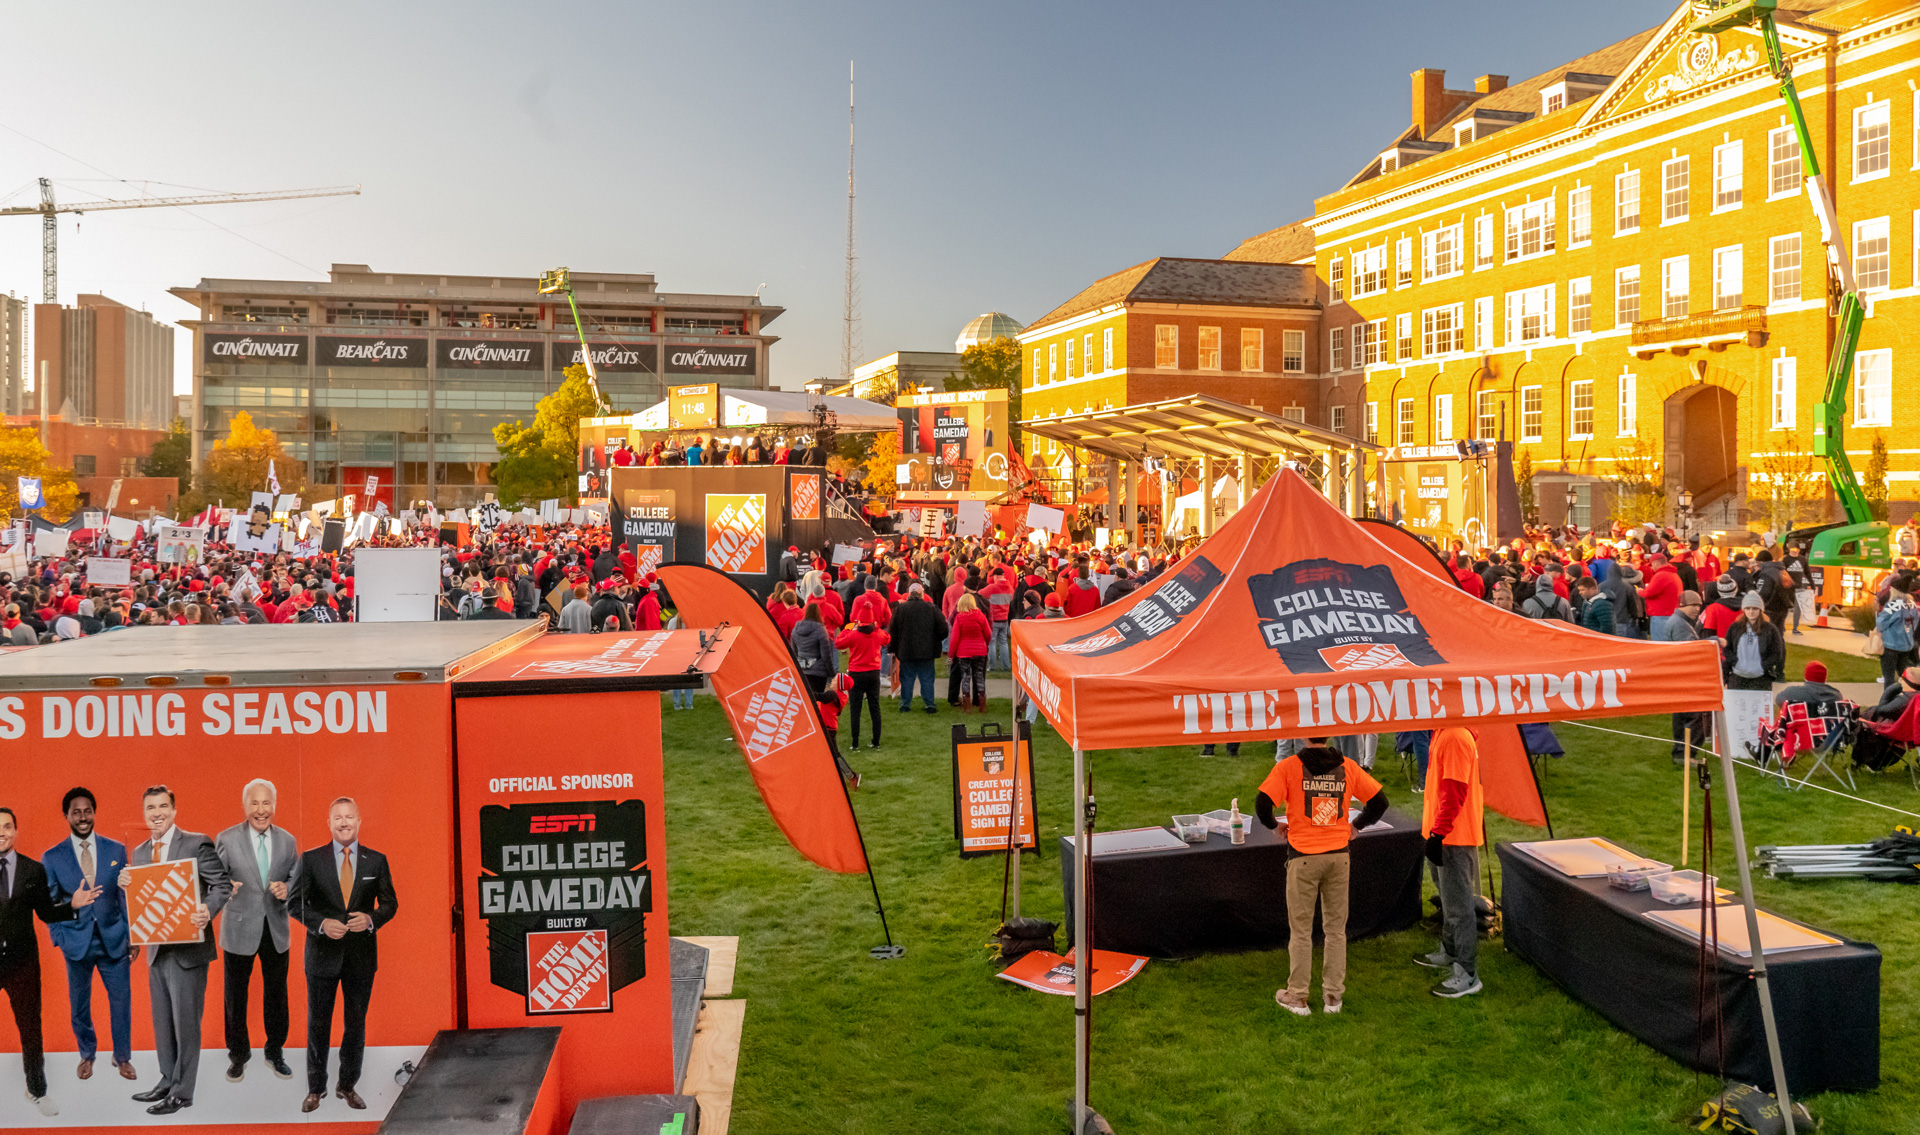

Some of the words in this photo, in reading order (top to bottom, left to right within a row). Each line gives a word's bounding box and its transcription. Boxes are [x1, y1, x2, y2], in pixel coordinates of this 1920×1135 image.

[212, 339, 299, 357] CINCINNATI
[336, 341, 408, 359] BEARCATS
[450, 344, 530, 362] CINCINNATI
[571, 348, 639, 365] BARCATS
[671, 349, 748, 367] CINCINNATI
[958, 391, 987, 402] DEPOT
[682, 402, 705, 415] 11:48
[938, 417, 964, 426] COLLEGE
[933, 427, 969, 438] GAMEDAY
[1430, 446, 1460, 457] GAMEDA
[794, 480, 805, 496] THE
[1421, 477, 1444, 485] COLLEGE
[639, 495, 660, 503] ESPN
[792, 475, 819, 518] HOME
[1418, 488, 1448, 498] GAMEDAY
[630, 507, 669, 519] COLLEGE
[802, 493, 819, 519] DEPOT
[712, 503, 736, 534] THE
[624, 521, 675, 537] GAMEDAY
[707, 494, 765, 570] HOME
[728, 524, 764, 572] DEPOT
[1294, 567, 1351, 586] ESPN
[1273, 587, 1390, 616] COLLEGE
[1263, 610, 1418, 646] GAMEDAY
[1334, 636, 1359, 644] BUILT
[1336, 649, 1364, 664] THE
[743, 692, 765, 724] THE
[1173, 690, 1282, 734] THE
[1297, 678, 1447, 728] HOME
[1458, 668, 1626, 718] DEPOT
[42, 693, 186, 738] DOING
[202, 691, 387, 736] SEASON
[749, 672, 793, 755] HOME
[773, 693, 804, 747] DEPOT
[489, 776, 557, 793] OFFICIAL
[561, 773, 634, 790] SPONSOR
[968, 780, 998, 789] CREATE
[1000, 779, 1021, 787] YOU
[1303, 781, 1345, 792] GAMEDAY
[1312, 798, 1338, 825] HOME
[1316, 801, 1326, 812] THE
[529, 813, 596, 834] ESPN
[971, 818, 995, 829] SIGN
[998, 816, 1025, 827] HEE
[502, 841, 626, 872] COLLEGE
[136, 879, 156, 905] THE
[482, 875, 647, 914] GAMEDAY
[130, 862, 194, 944] HOME
[157, 894, 195, 941] DEPOT
[547, 918, 573, 928] BUILT
[575, 918, 588, 928] BY
[536, 940, 568, 972] THE
[529, 931, 606, 1010] HOME
[560, 959, 607, 1010] DEPOT
